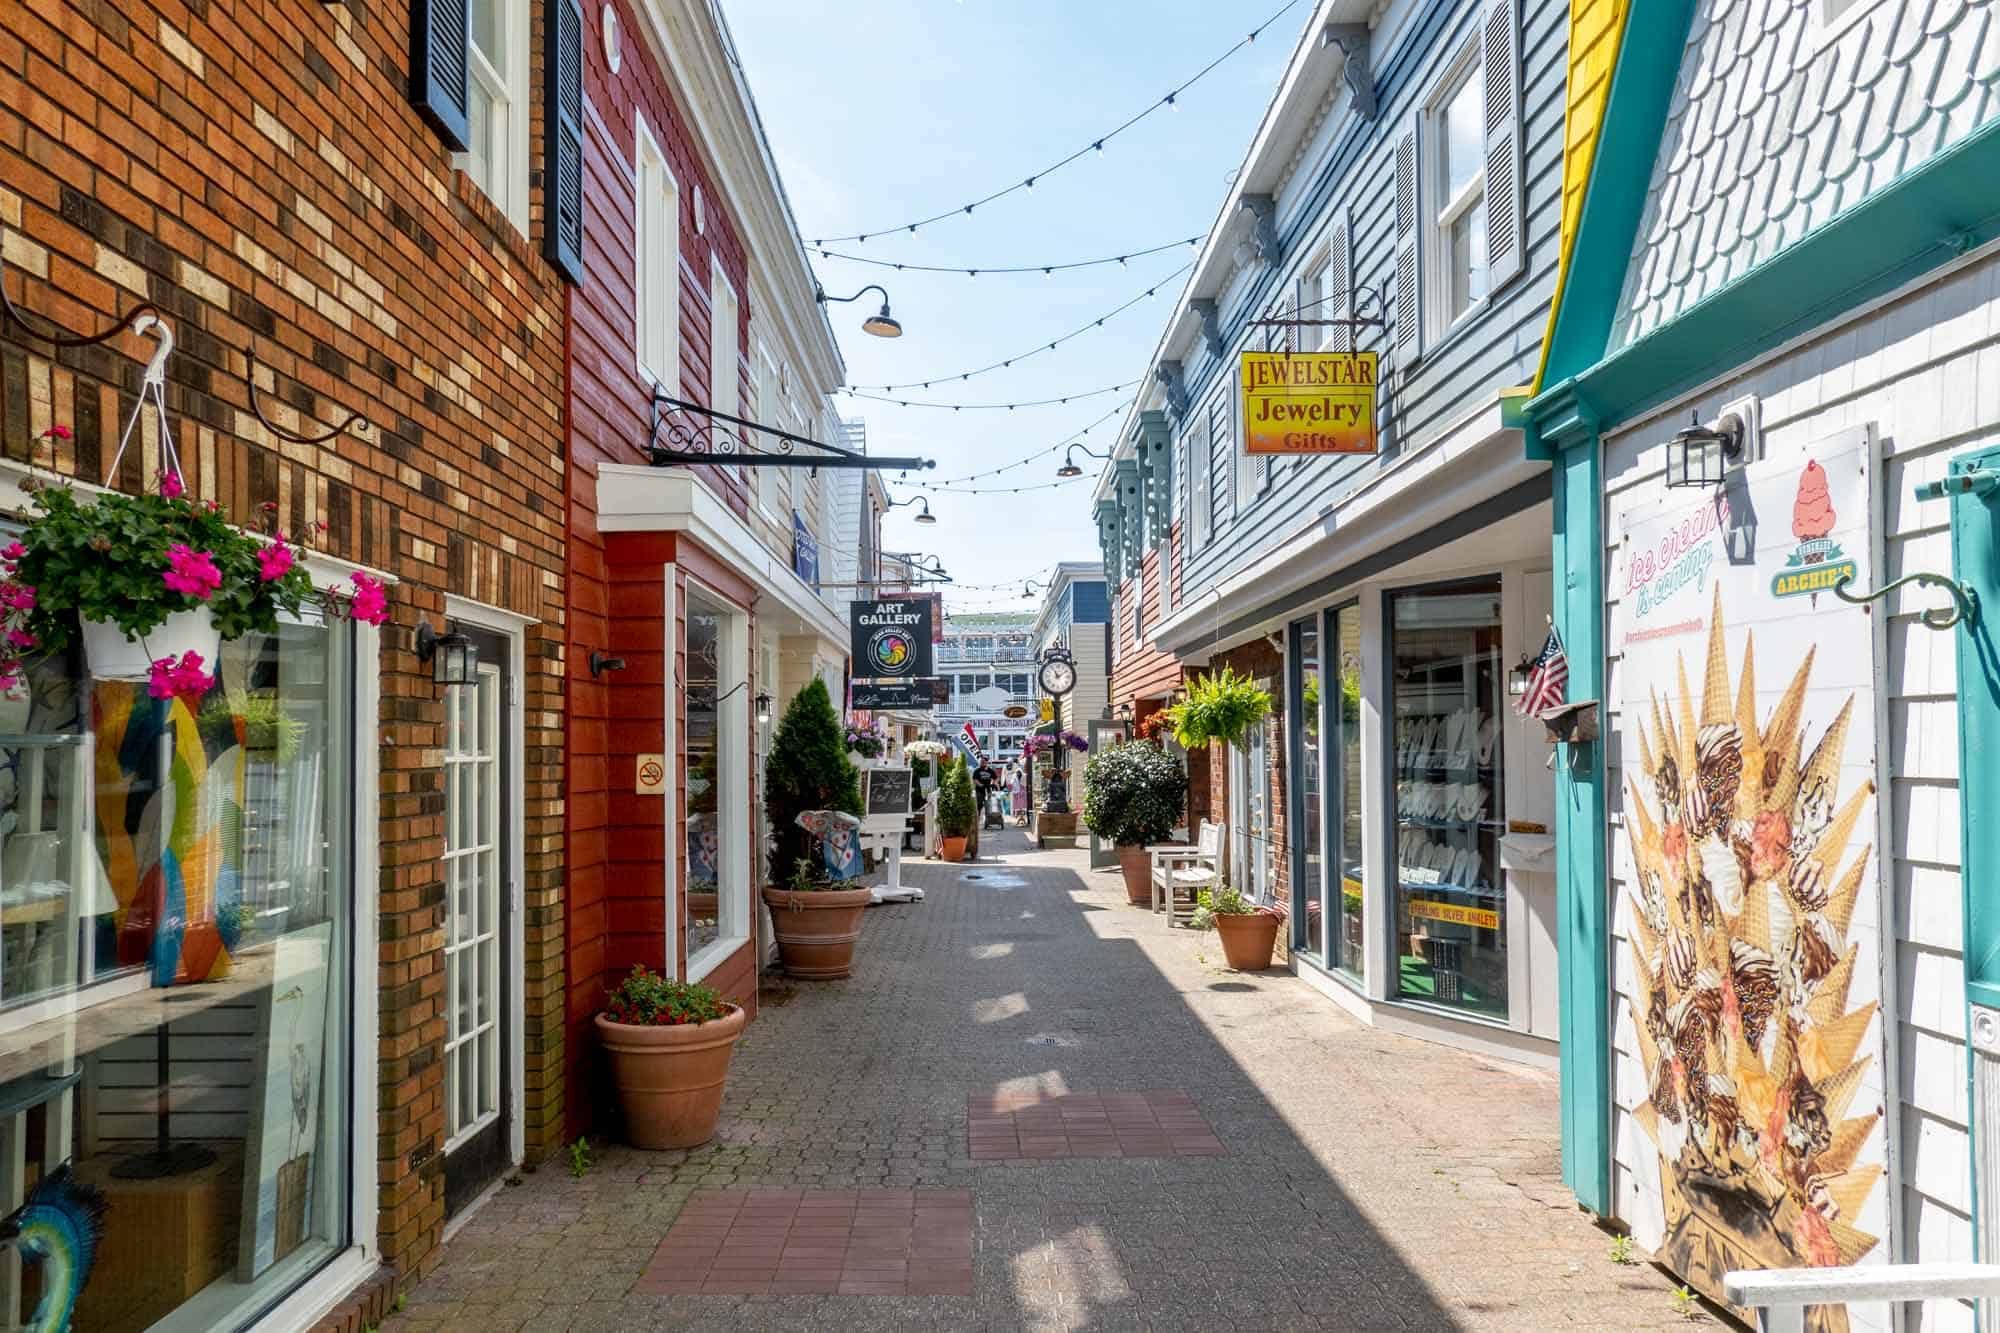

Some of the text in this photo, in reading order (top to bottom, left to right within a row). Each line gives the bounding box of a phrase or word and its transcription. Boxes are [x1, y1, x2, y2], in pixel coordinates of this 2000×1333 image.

[1248, 360, 1372, 392] JEWELSTAR
[1256, 398, 1362, 427] Jewelry
[1283, 432, 1337, 449] Gifts
[1775, 565, 1853, 595] ARCHIE'S
[859, 614, 921, 625] GALLERY
[876, 603, 904, 614] ART
[961, 733, 983, 760] OPEN
